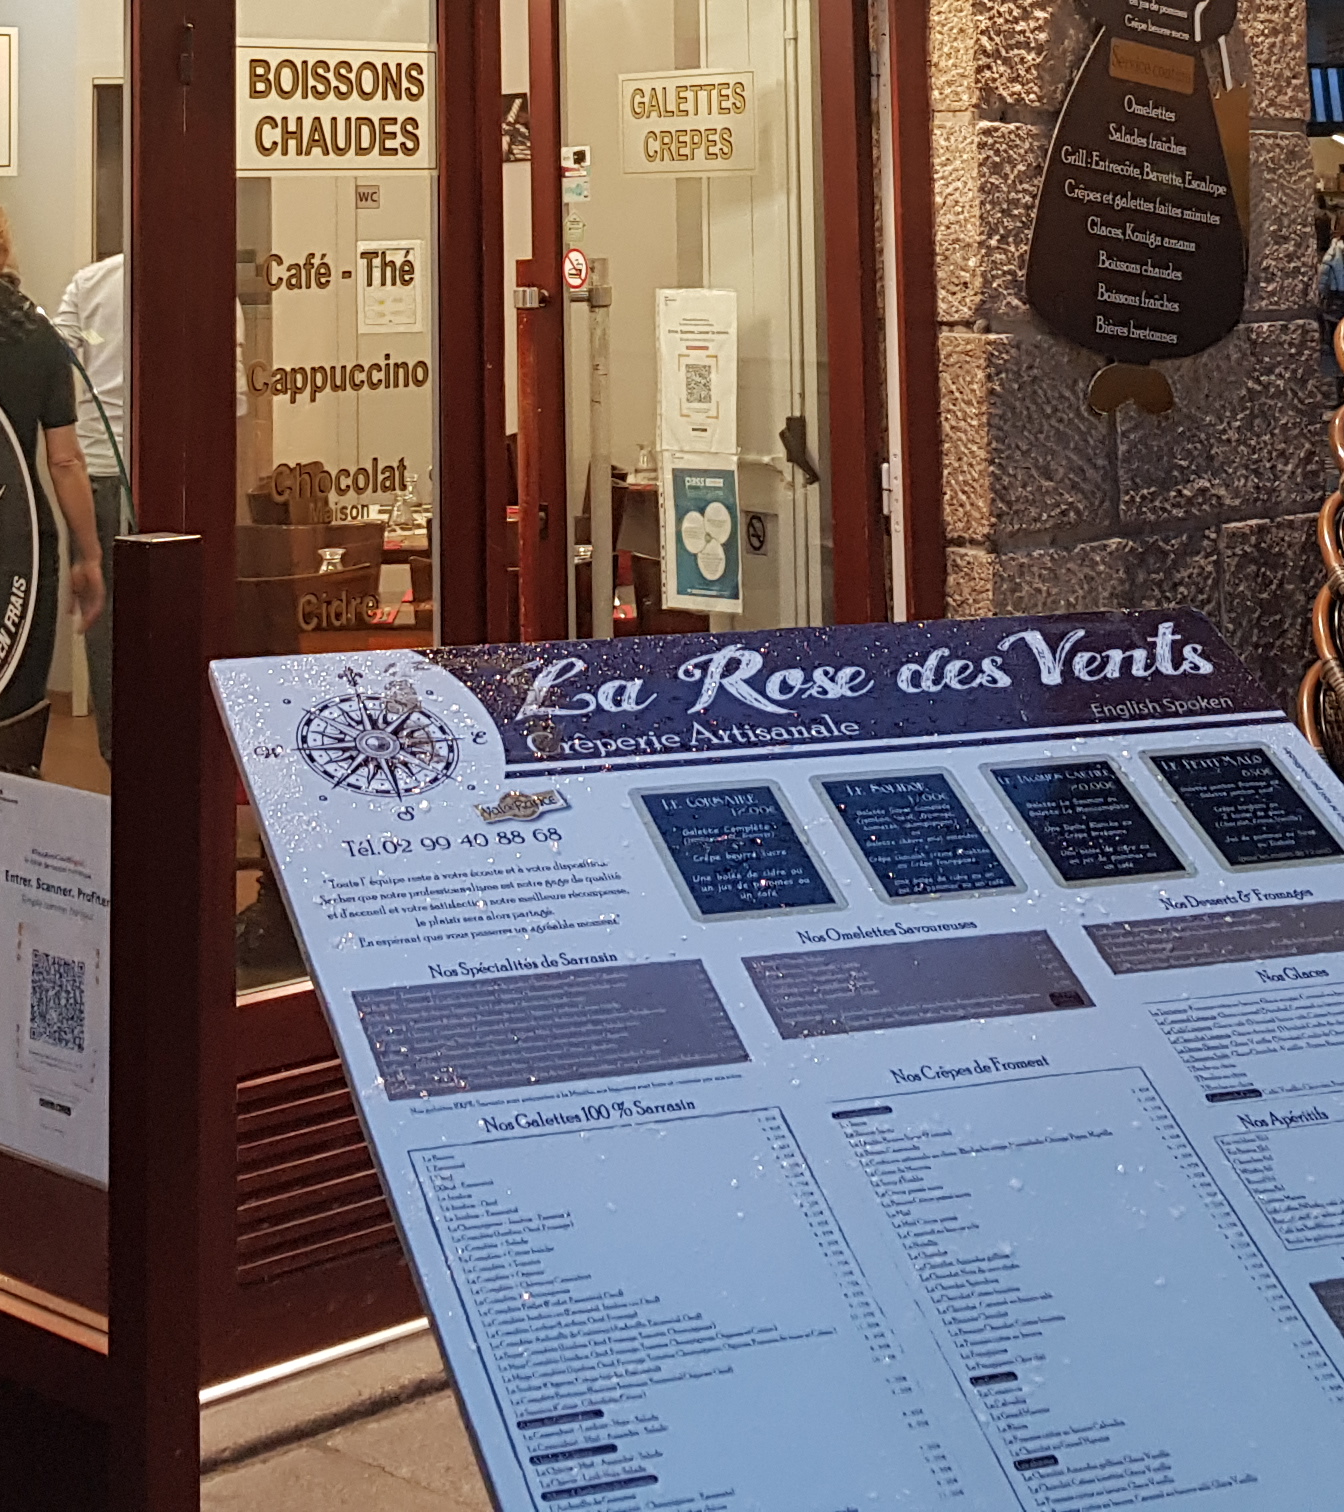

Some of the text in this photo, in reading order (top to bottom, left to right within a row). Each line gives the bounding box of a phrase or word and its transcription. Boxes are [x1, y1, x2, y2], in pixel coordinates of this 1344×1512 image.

[249, 58, 425, 102] BOISSONS
[629, 81, 747, 121] GALETTES
[1124, 94, 1176, 122] Omelettes
[255, 115, 420, 157] CHAUDES
[642, 126, 734, 163] CREPES
[1108, 123, 1187, 156] Salades fraîches
[358, 191, 378, 203] WC
[1064, 178, 1220, 225] Crêpes et galettes faites minutes
[263, 250, 415, 291] Café Thé
[1098, 250, 1182, 281] Boissons chaudes
[1097, 282, 1179, 313] Boissons fraîches
[1095, 315, 1178, 345] Bières bretonnes
[246, 353, 429, 404] Cappuccino
[271, 456, 407, 505] Chocolat
[308, 500, 370, 523] Maison
[4, 574, 27, 628] FRAIS
[297, 590, 379, 632] Cidre
[513, 621, 1215, 723] La Rose des Vents
[1091, 692, 1234, 725] English Spoken
[526, 713, 861, 760] Crêperie Artisanale
[421, 832, 453, 851] 99
[459, 830, 490, 848] 40
[495, 829, 527, 845] 88
[532, 825, 564, 843] 68
[1160, 894, 1187, 910] Nos
[1186, 891, 1239, 909] Desserts
[1254, 887, 1314, 904] Fromages
[798, 920, 978, 945] Nos Omelettes Savoureuses
[428, 952, 618, 979] Nos Spécialités de Sarrasin
[1257, 966, 1330, 984] Nos Glaces
[890, 1055, 1051, 1085] Nos Crêpes de Froment
[482, 1098, 697, 1134] Nos Galettes 100 % Sarrasin
[1237, 1108, 1329, 1129] Nos Apéritifs
